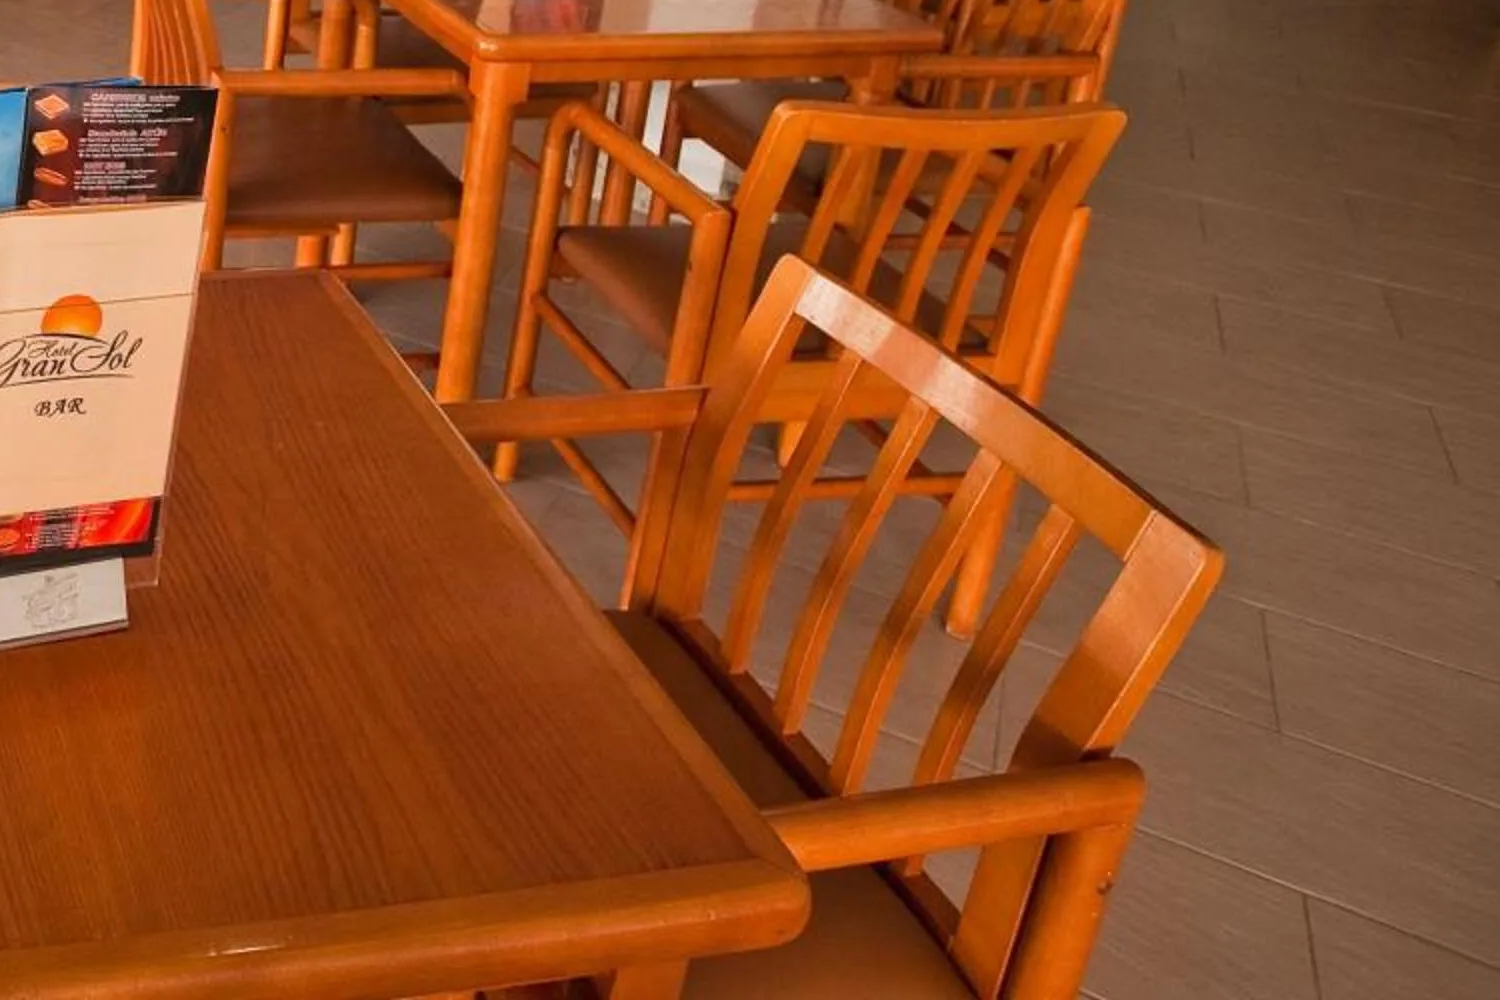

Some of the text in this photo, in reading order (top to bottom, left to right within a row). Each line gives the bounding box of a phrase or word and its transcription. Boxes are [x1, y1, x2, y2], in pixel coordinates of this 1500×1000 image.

[27, 339, 78, 359] Hotel
[71, 329, 143, 373] Sol
[33, 397, 87, 417] BAR
